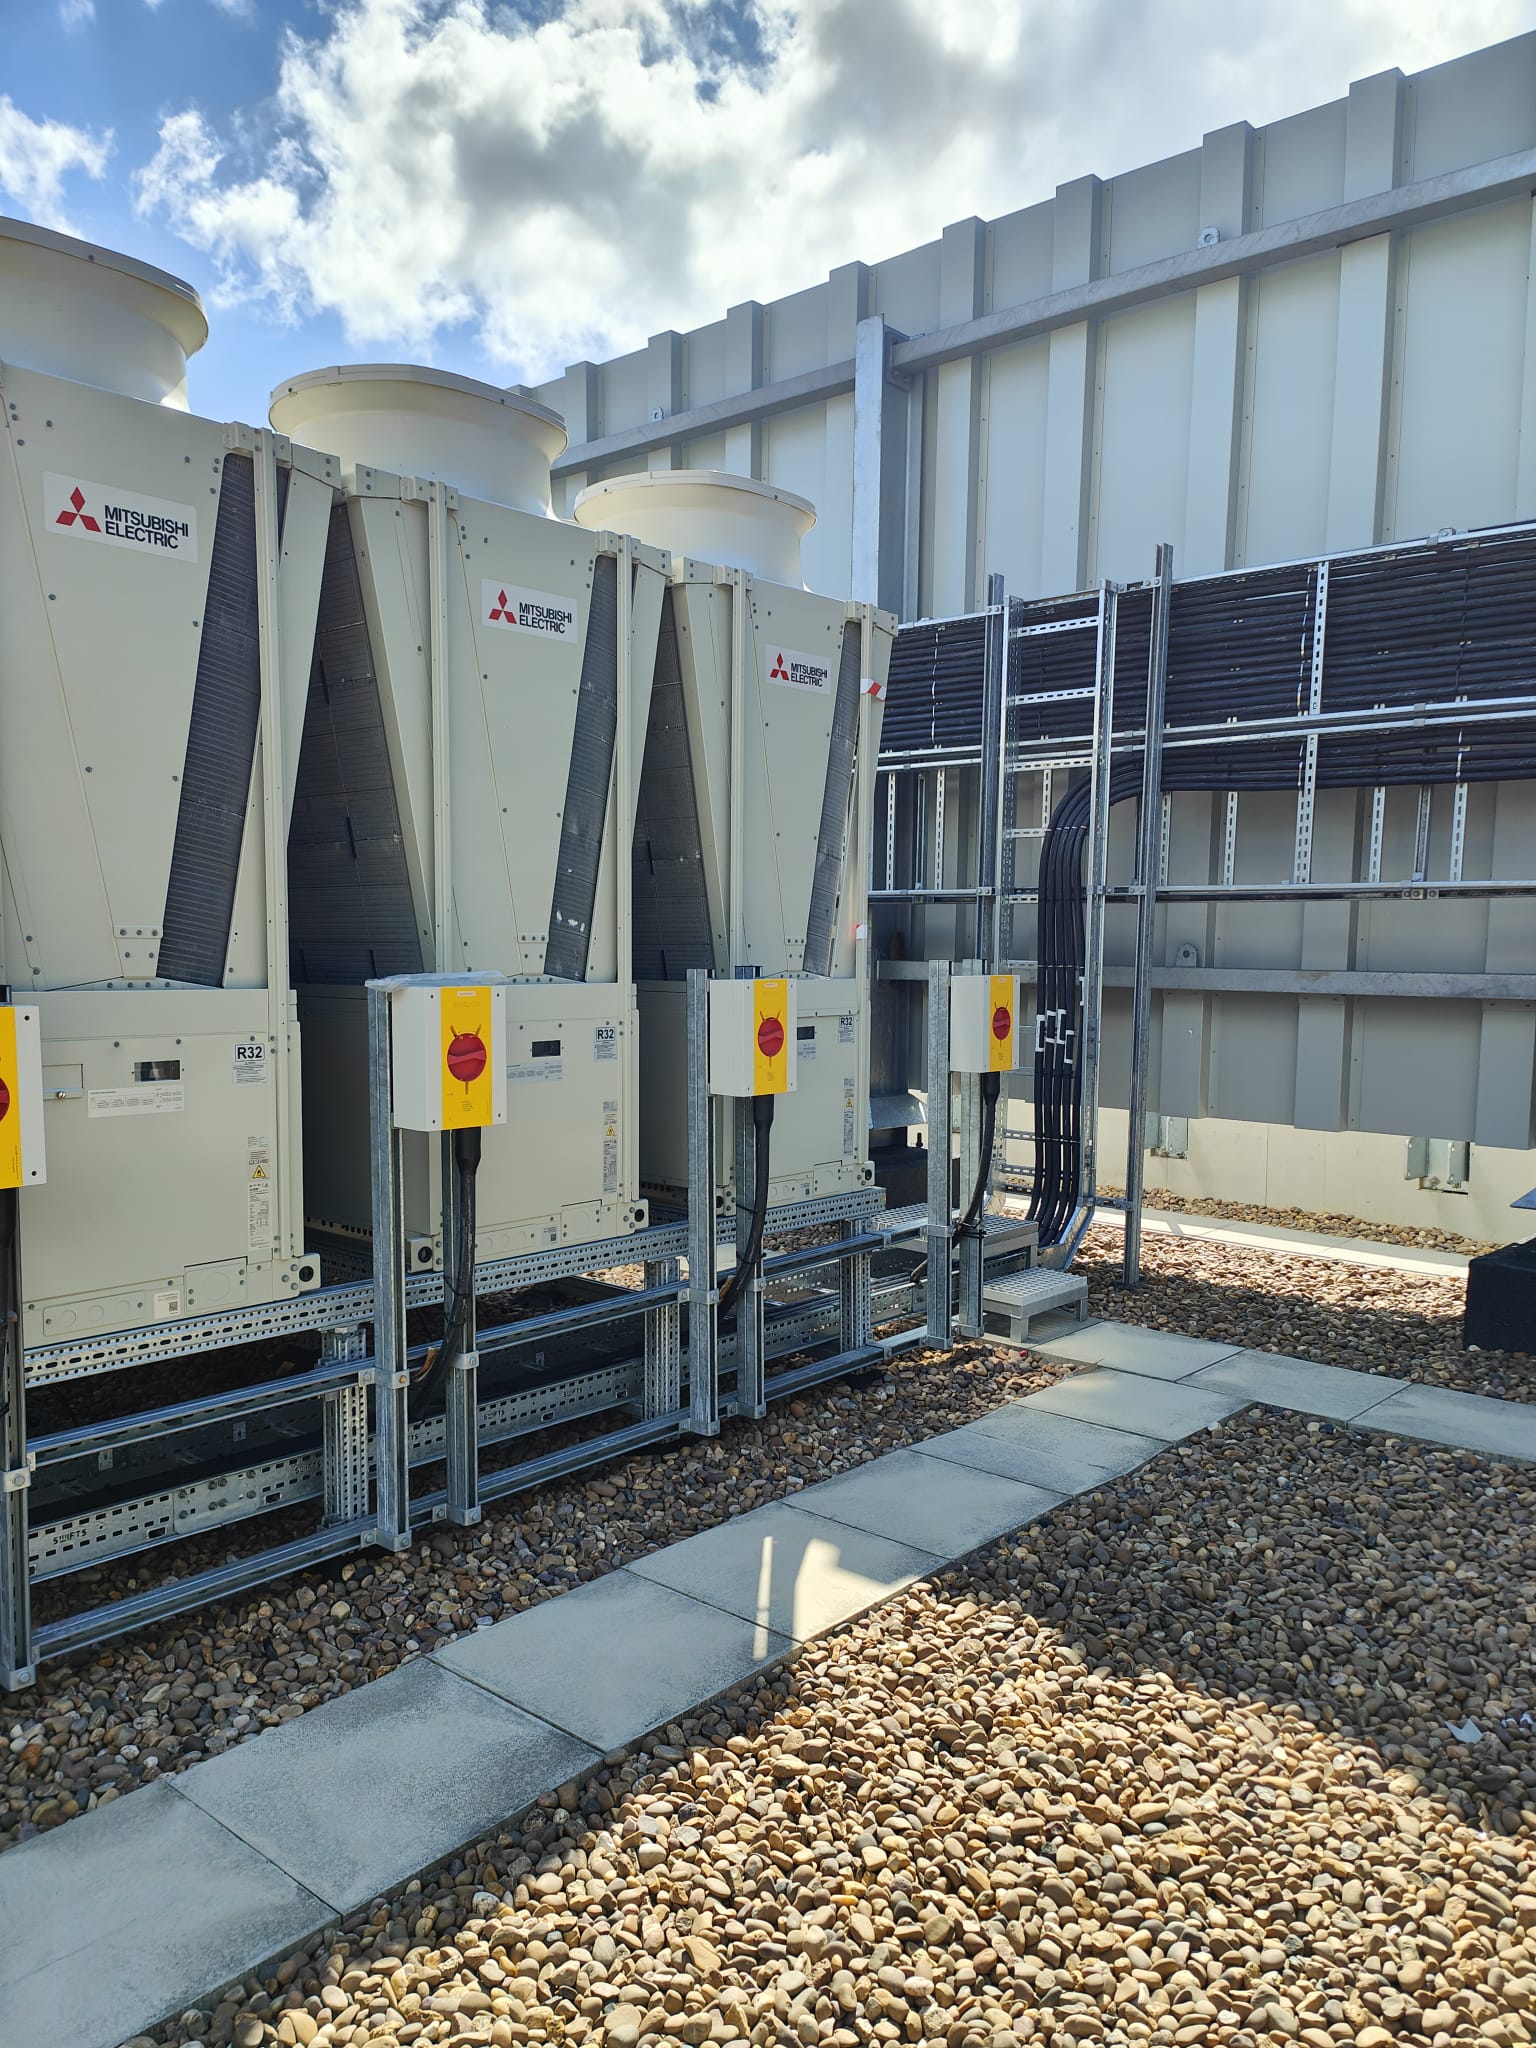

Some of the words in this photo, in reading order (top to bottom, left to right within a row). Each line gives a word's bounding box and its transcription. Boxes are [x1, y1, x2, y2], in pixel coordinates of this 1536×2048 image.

[104, 504, 189, 537] MITSUBISHI
[105, 521, 179, 549] ELECTRIC
[519, 602, 572, 624] MITSUBISHI
[519, 615, 566, 634] ELECTRIC
[790, 662, 828, 679] MITSUBISHI
[790, 673, 823, 687] ELECTRIC
[840, 1016, 853, 1027] R32
[597, 1029, 615, 1040] R32
[237, 1046, 263, 1060] R32
[563, 1387, 582, 1398] SFTS
[484, 1409, 505, 1421] SFTS
[52, 1529, 87, 1545] SWIFTS
